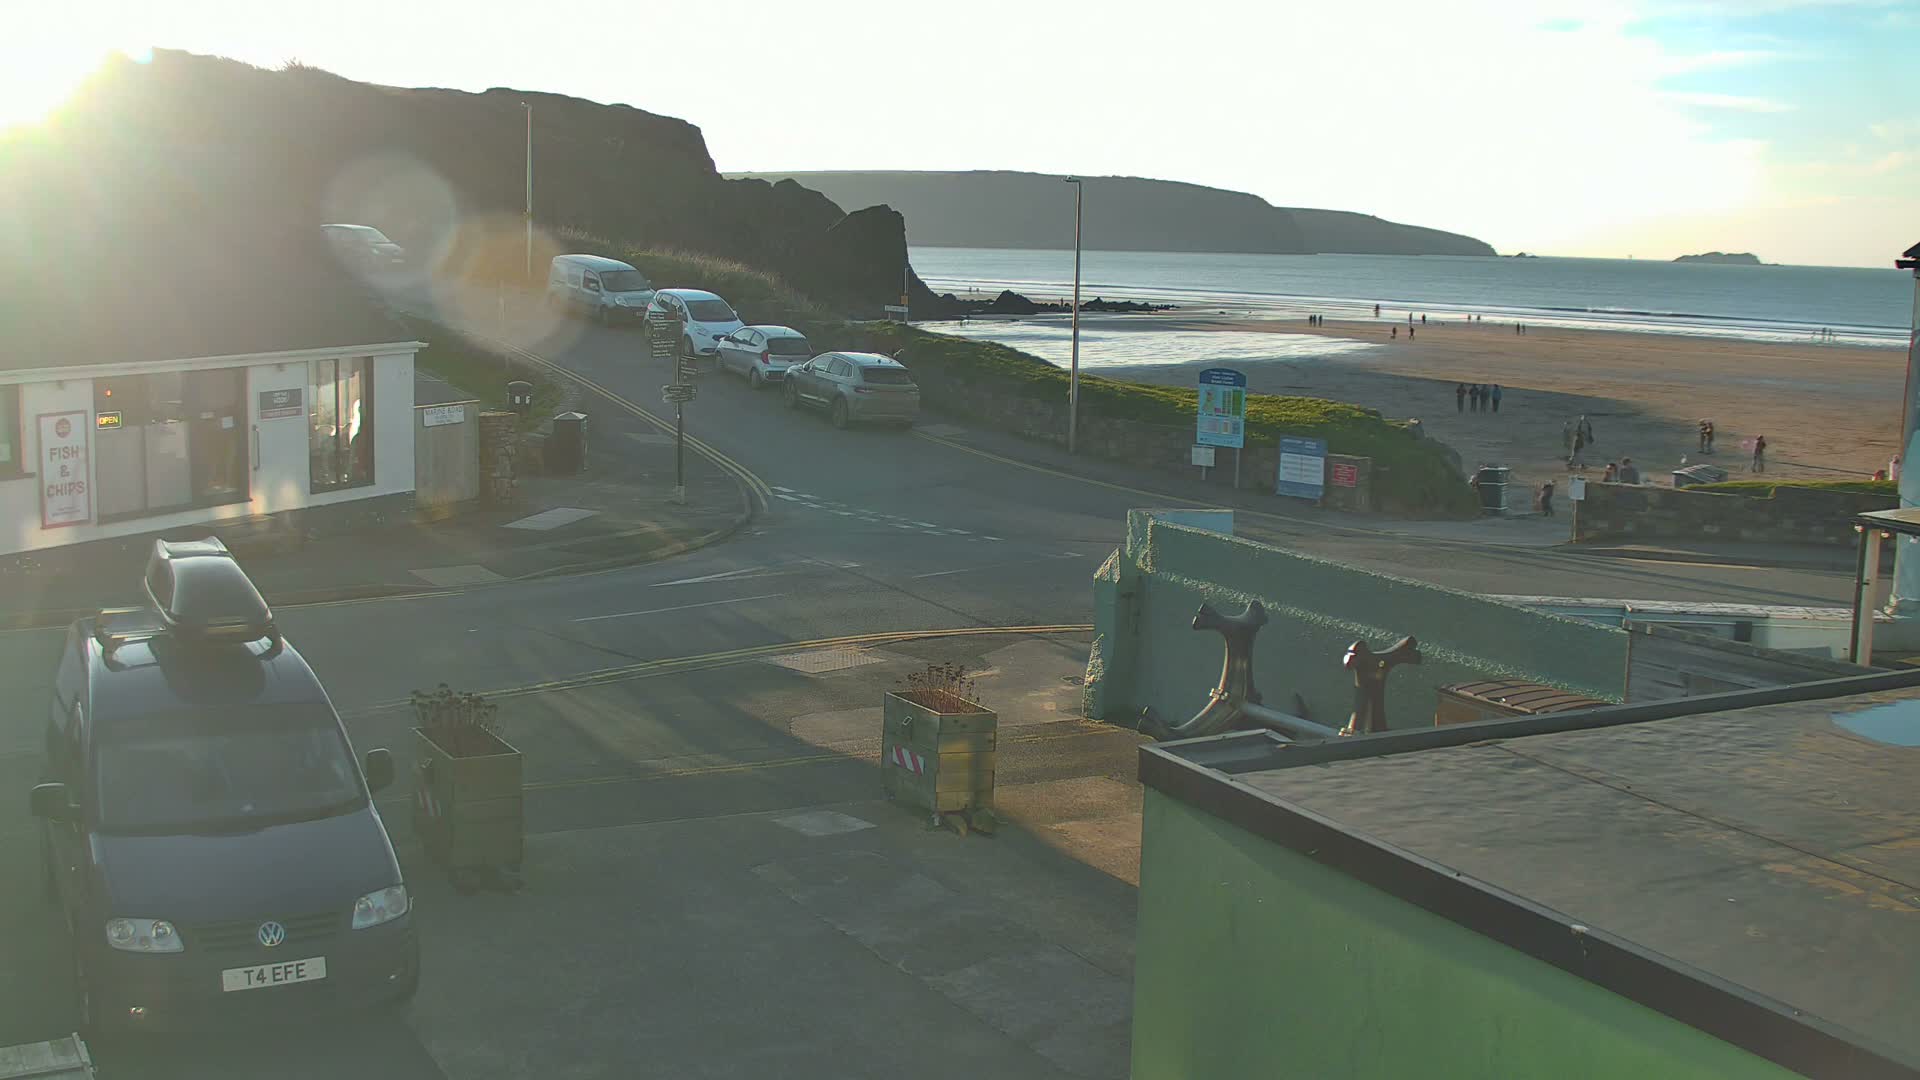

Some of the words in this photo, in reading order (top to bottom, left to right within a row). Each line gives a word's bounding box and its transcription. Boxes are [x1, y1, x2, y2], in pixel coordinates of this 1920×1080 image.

[99, 416, 119, 425] OPEN
[49, 446, 79, 462] FISH
[60, 464, 70, 477] &
[46, 481, 85, 498] CHIPS
[243, 968, 267, 986] T4
[272, 962, 306, 982] EFE
